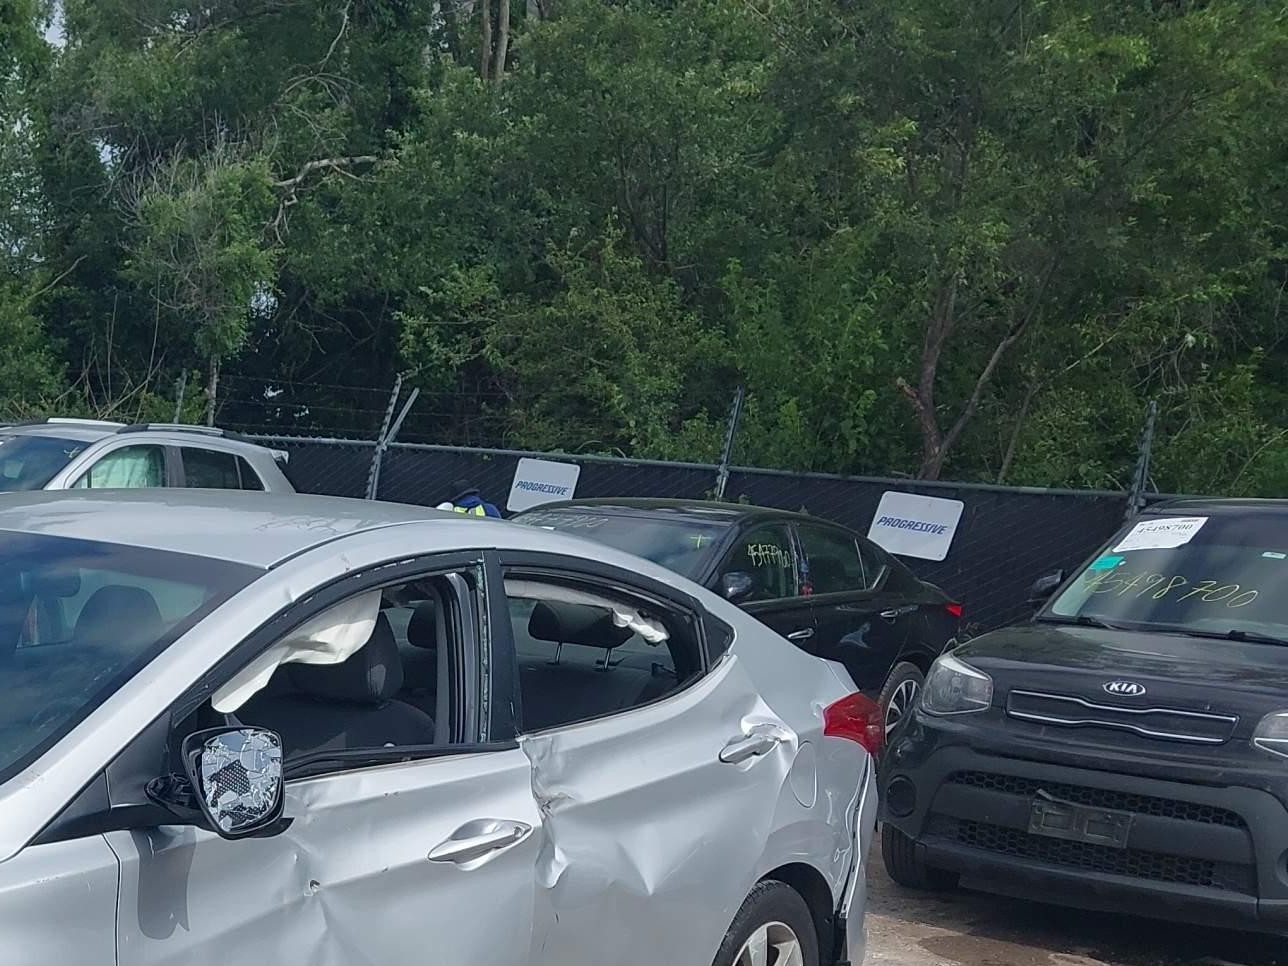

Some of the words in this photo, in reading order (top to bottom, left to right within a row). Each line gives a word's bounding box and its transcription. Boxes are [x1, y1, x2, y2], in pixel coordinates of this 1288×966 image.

[515, 480, 569, 496] PROGRESSIVE
[876, 516, 948, 535] PROGRESSIVE
[1108, 681, 1139, 694] KIA
